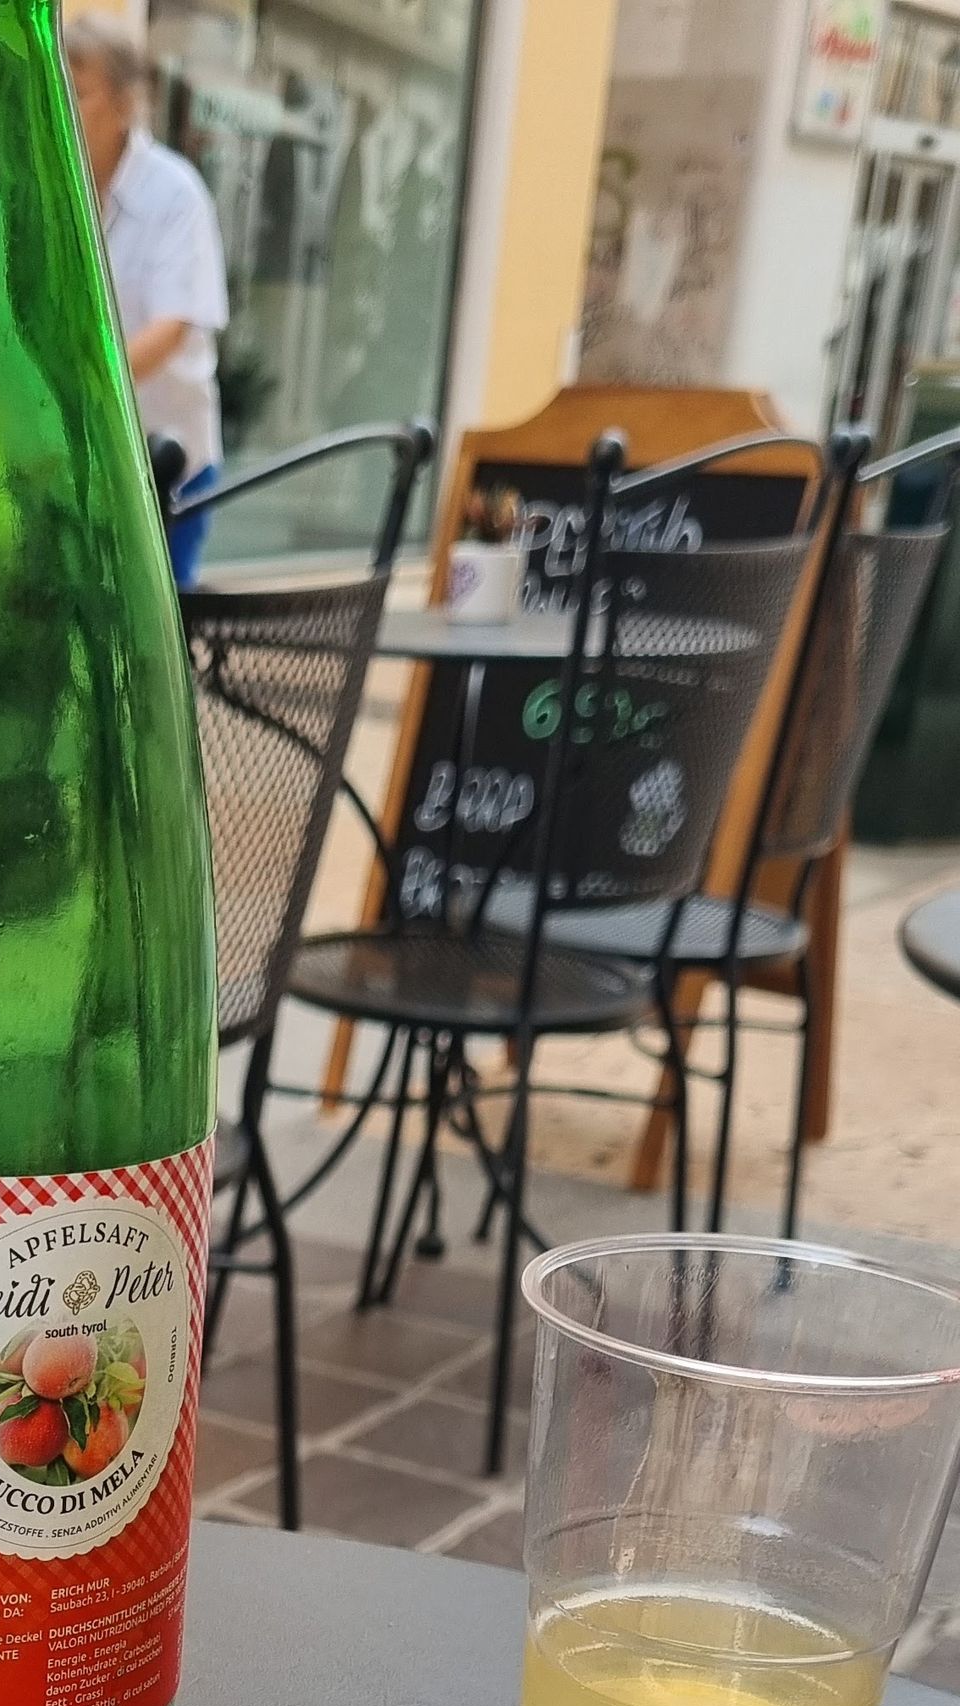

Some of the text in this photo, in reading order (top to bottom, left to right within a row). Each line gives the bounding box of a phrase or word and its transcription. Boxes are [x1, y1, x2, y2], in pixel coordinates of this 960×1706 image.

[9, 1222, 149, 1269] APFELSAFT
[105, 1260, 174, 1309] Peter
[45, 1319, 108, 1339] south tyrol
[168, 1326, 177, 1383] TORBIDO
[51, 1526, 83, 1538] SENZA
[85, 1504, 121, 1531] ADDITIVI
[122, 1454, 158, 1507] ALIMENTARI
[60, 1491, 86, 1514] DI
[90, 1450, 144, 1505] MELA
[0, 1593, 32, 1605] VON:
[50, 1595, 93, 1613] Saubach
[95, 1592, 109, 1603] 23,
[121, 1576, 145, 1595] 39040
[51, 1577, 110, 1600] ERICH MUR
[3, 1607, 24, 1618] DA:
[49, 1600, 146, 1639] DURCHSCHNITTLICHE
[5, 1630, 43, 1644] Deckel
[48, 1635, 87, 1652] VALORI
[89, 1612, 149, 1642] NUTRIZIONALI
[47, 1657, 117, 1683] Kohlenhydrate
[48, 1653, 87, 1669] Energie
[94, 1640, 127, 1658] Energia
[46, 1682, 77, 1696] davon
[80, 1672, 111, 1689] Zucker
[117, 1665, 125, 1677] di
[125, 1662, 137, 1673] cui
[123, 1690, 131, 1700] di
[132, 1682, 142, 1696] cui
[75, 1687, 104, 1704] Grassi
